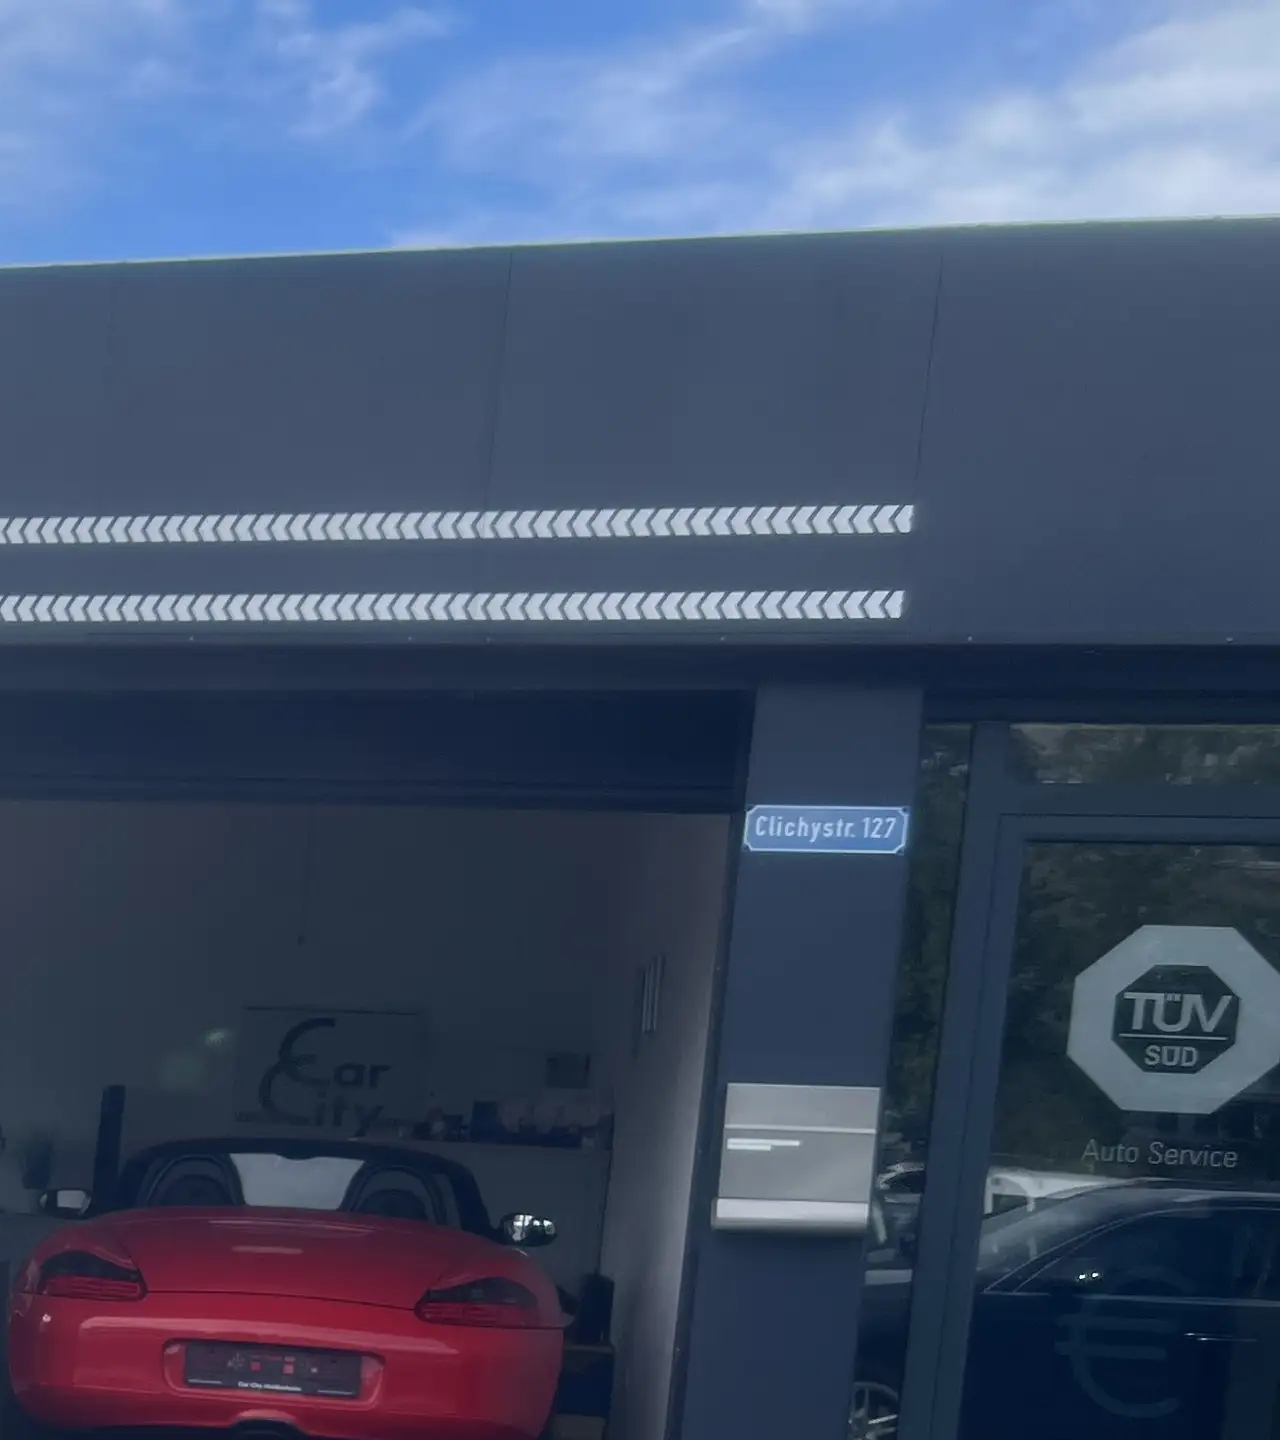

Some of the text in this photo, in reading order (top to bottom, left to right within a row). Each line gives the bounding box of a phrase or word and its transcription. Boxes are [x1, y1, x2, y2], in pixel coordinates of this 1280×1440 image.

[755, 815, 896, 843] Clichystr. 127
[1123, 991, 1233, 1034] TÜV
[1081, 1138, 1239, 1168] Auto Service
